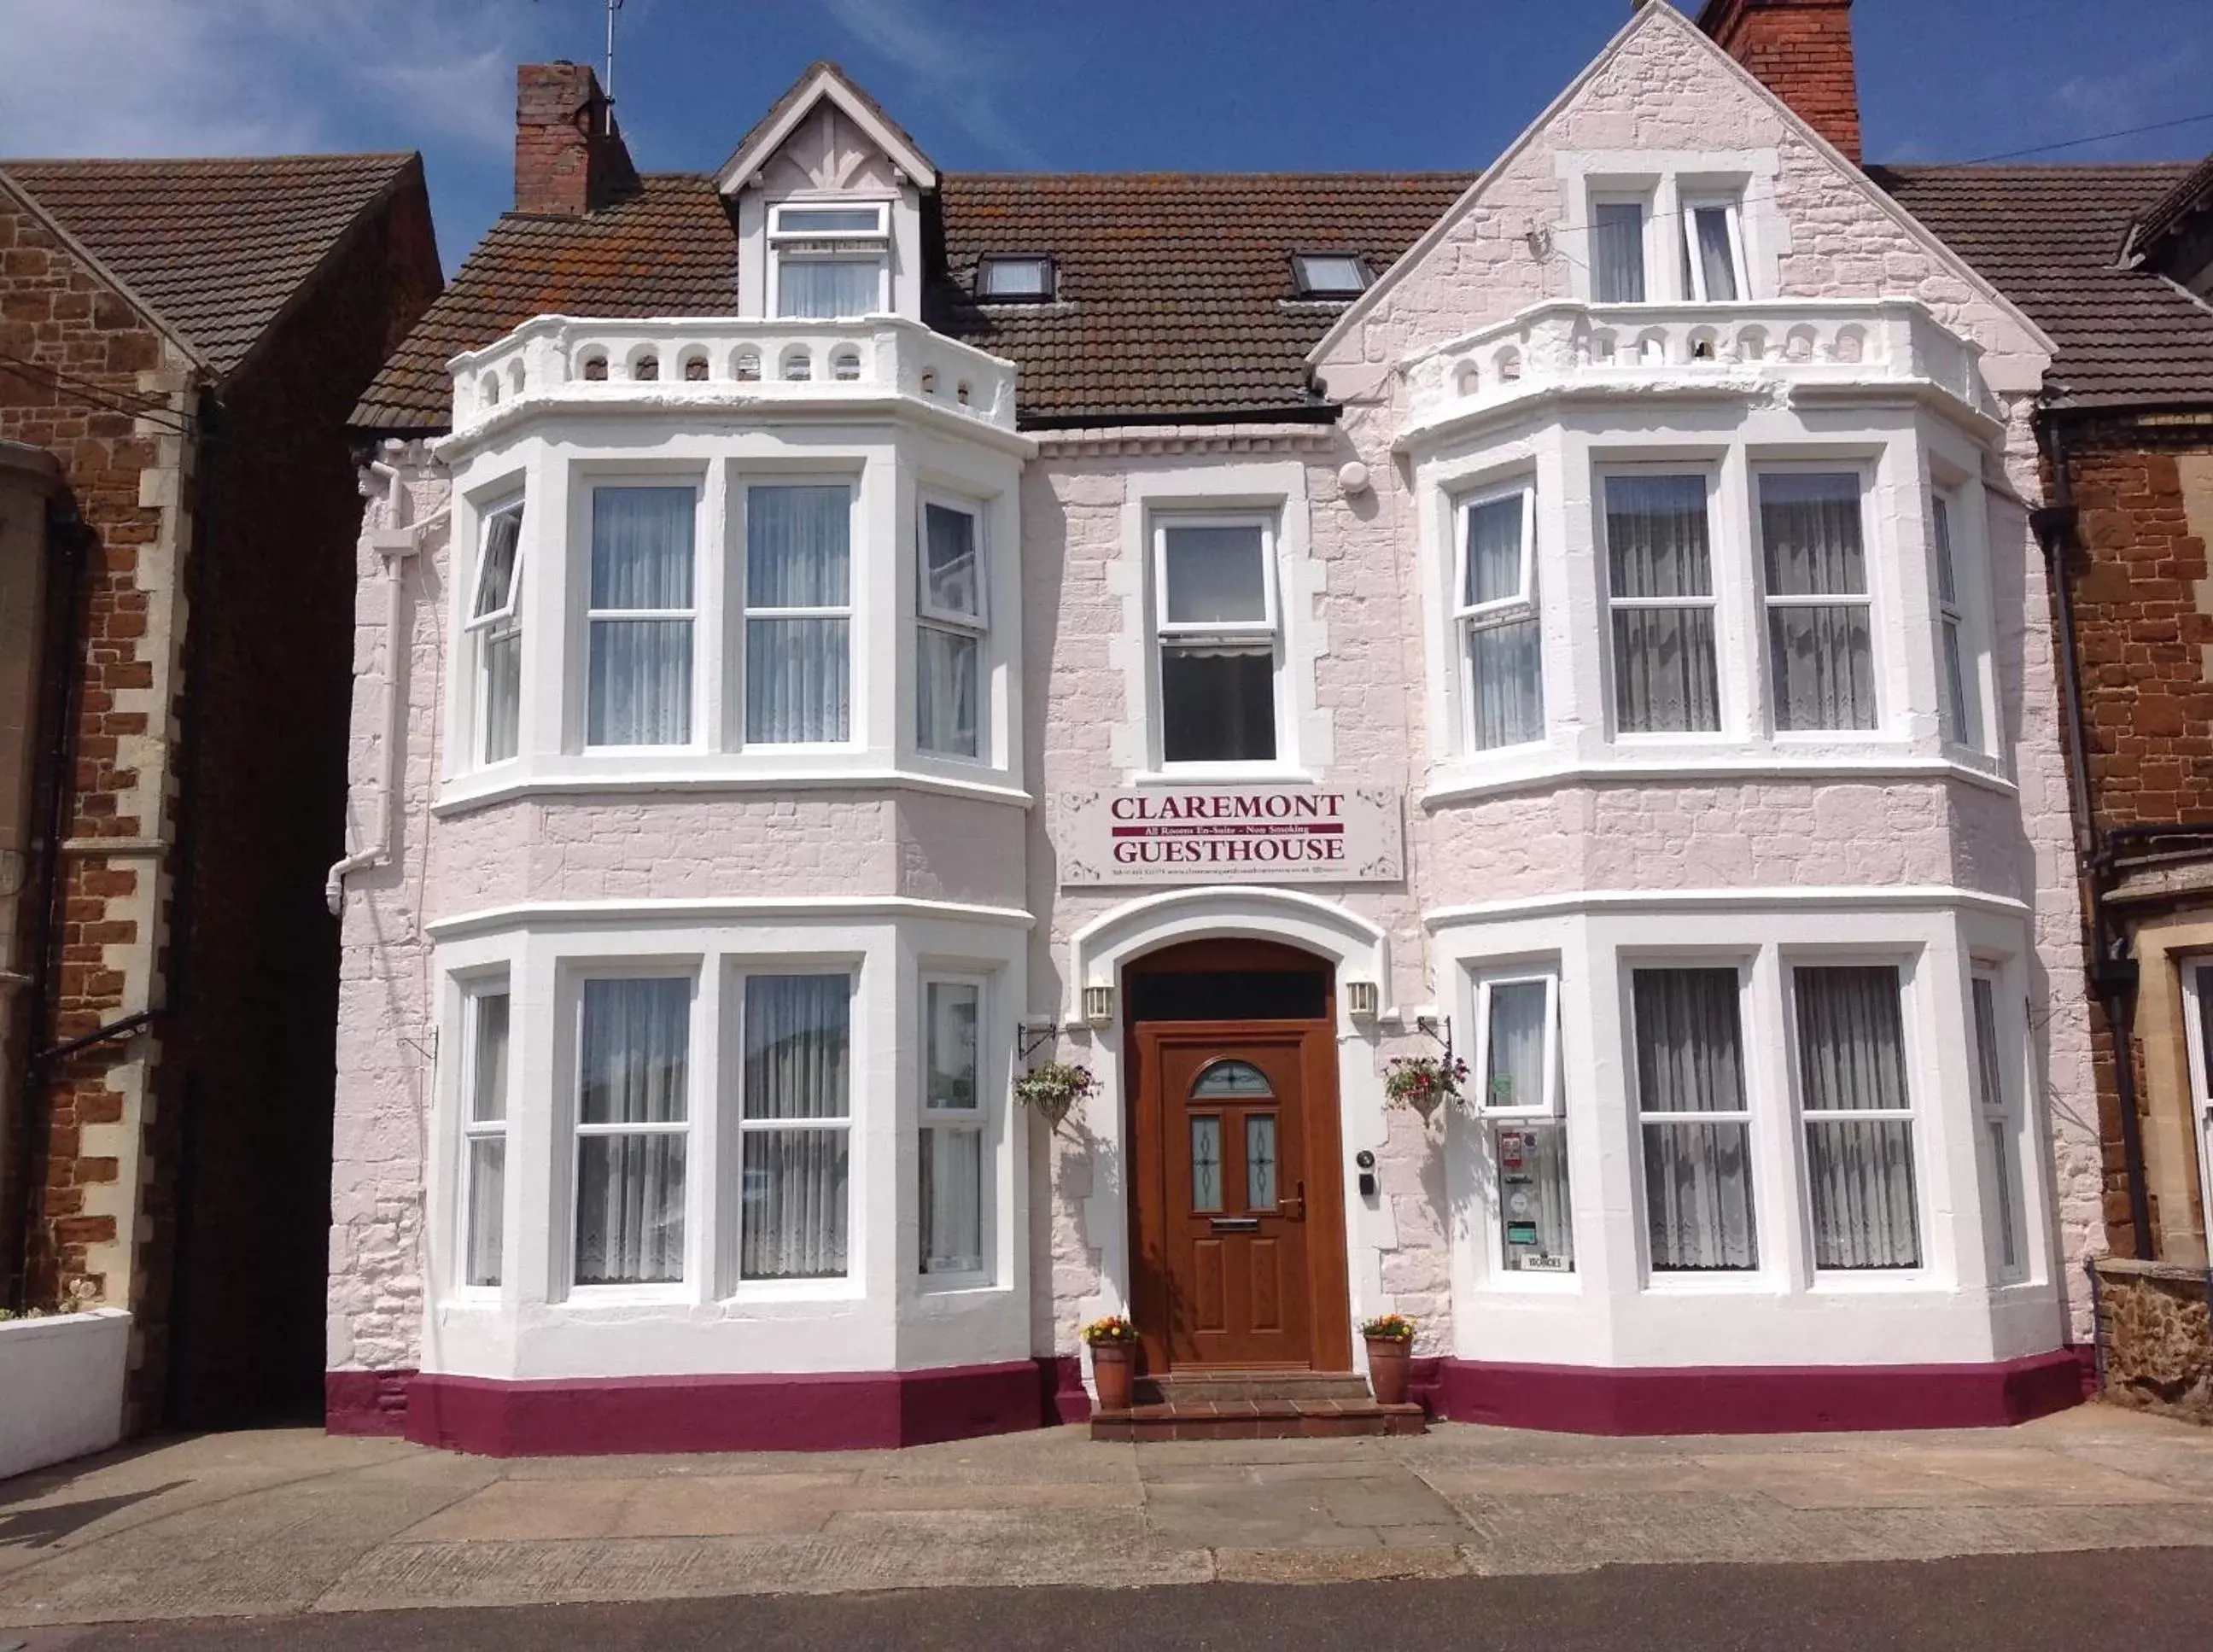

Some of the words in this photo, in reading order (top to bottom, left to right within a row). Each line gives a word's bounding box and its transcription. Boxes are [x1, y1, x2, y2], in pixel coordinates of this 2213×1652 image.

[1112, 794, 1346, 820] CLAREMONT
[1161, 826, 1193, 836] Rooms
[1196, 826, 1235, 835] En-Suite
[1247, 826, 1266, 834] Non
[1269, 825, 1310, 835] Smoking
[1113, 838, 1346, 863] GUESTHOUSE
